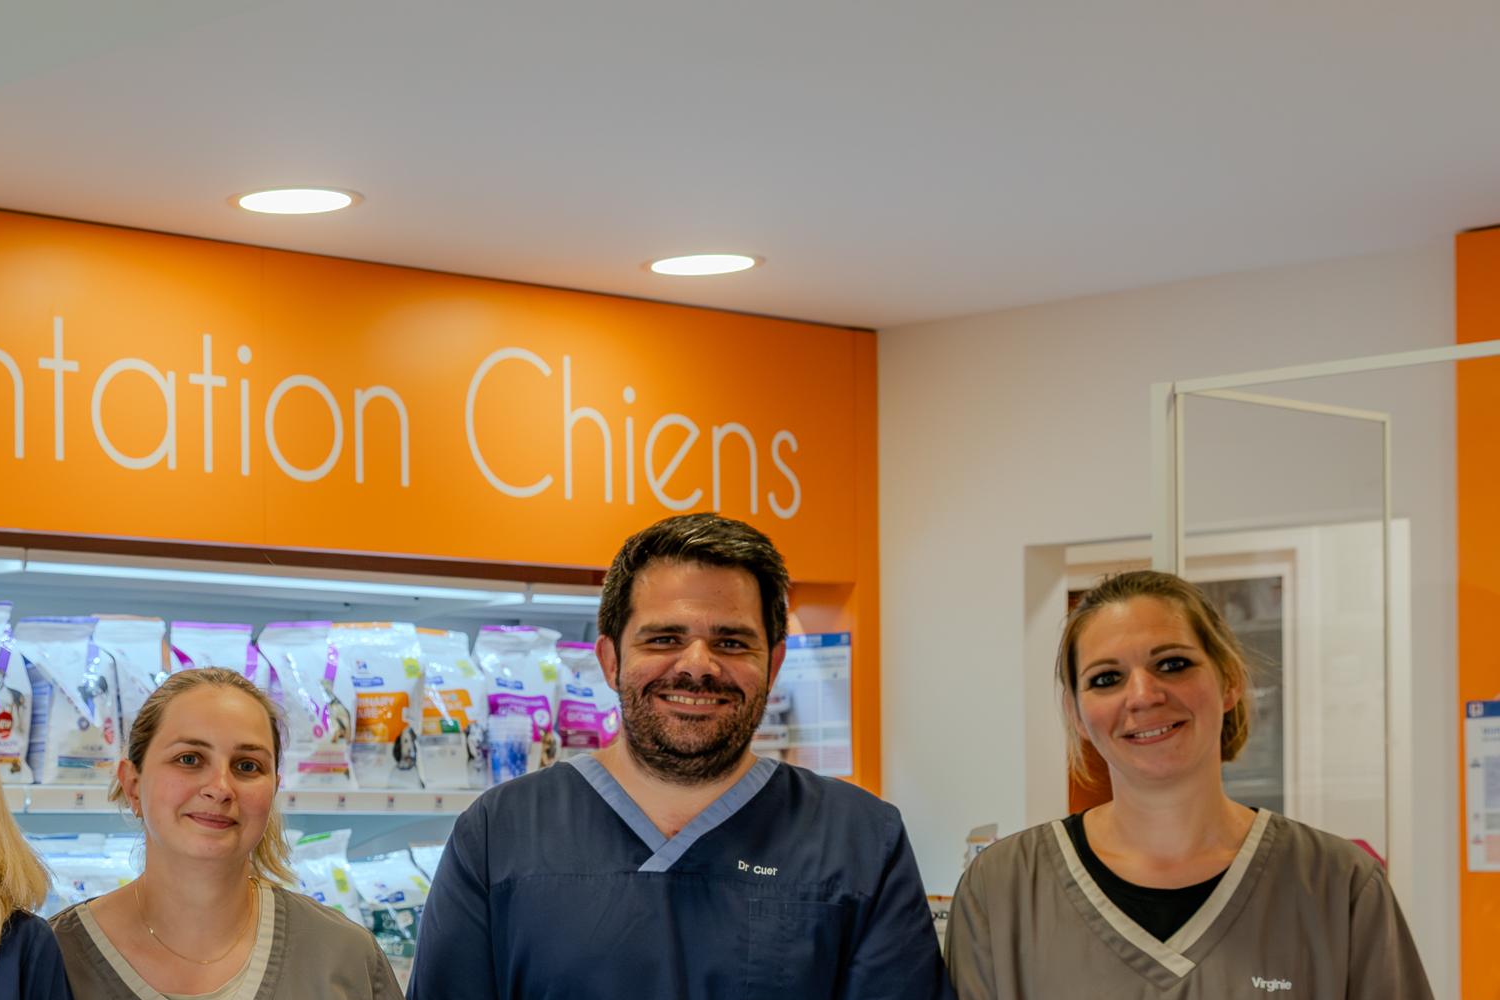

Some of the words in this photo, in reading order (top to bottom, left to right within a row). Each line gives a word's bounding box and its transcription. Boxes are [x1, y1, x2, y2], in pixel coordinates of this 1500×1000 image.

[465, 346, 801, 520] Chiens
[738, 860, 750, 872] Dr
[753, 865, 778, 876] Cuer
[1251, 976, 1292, 992] Virginie
